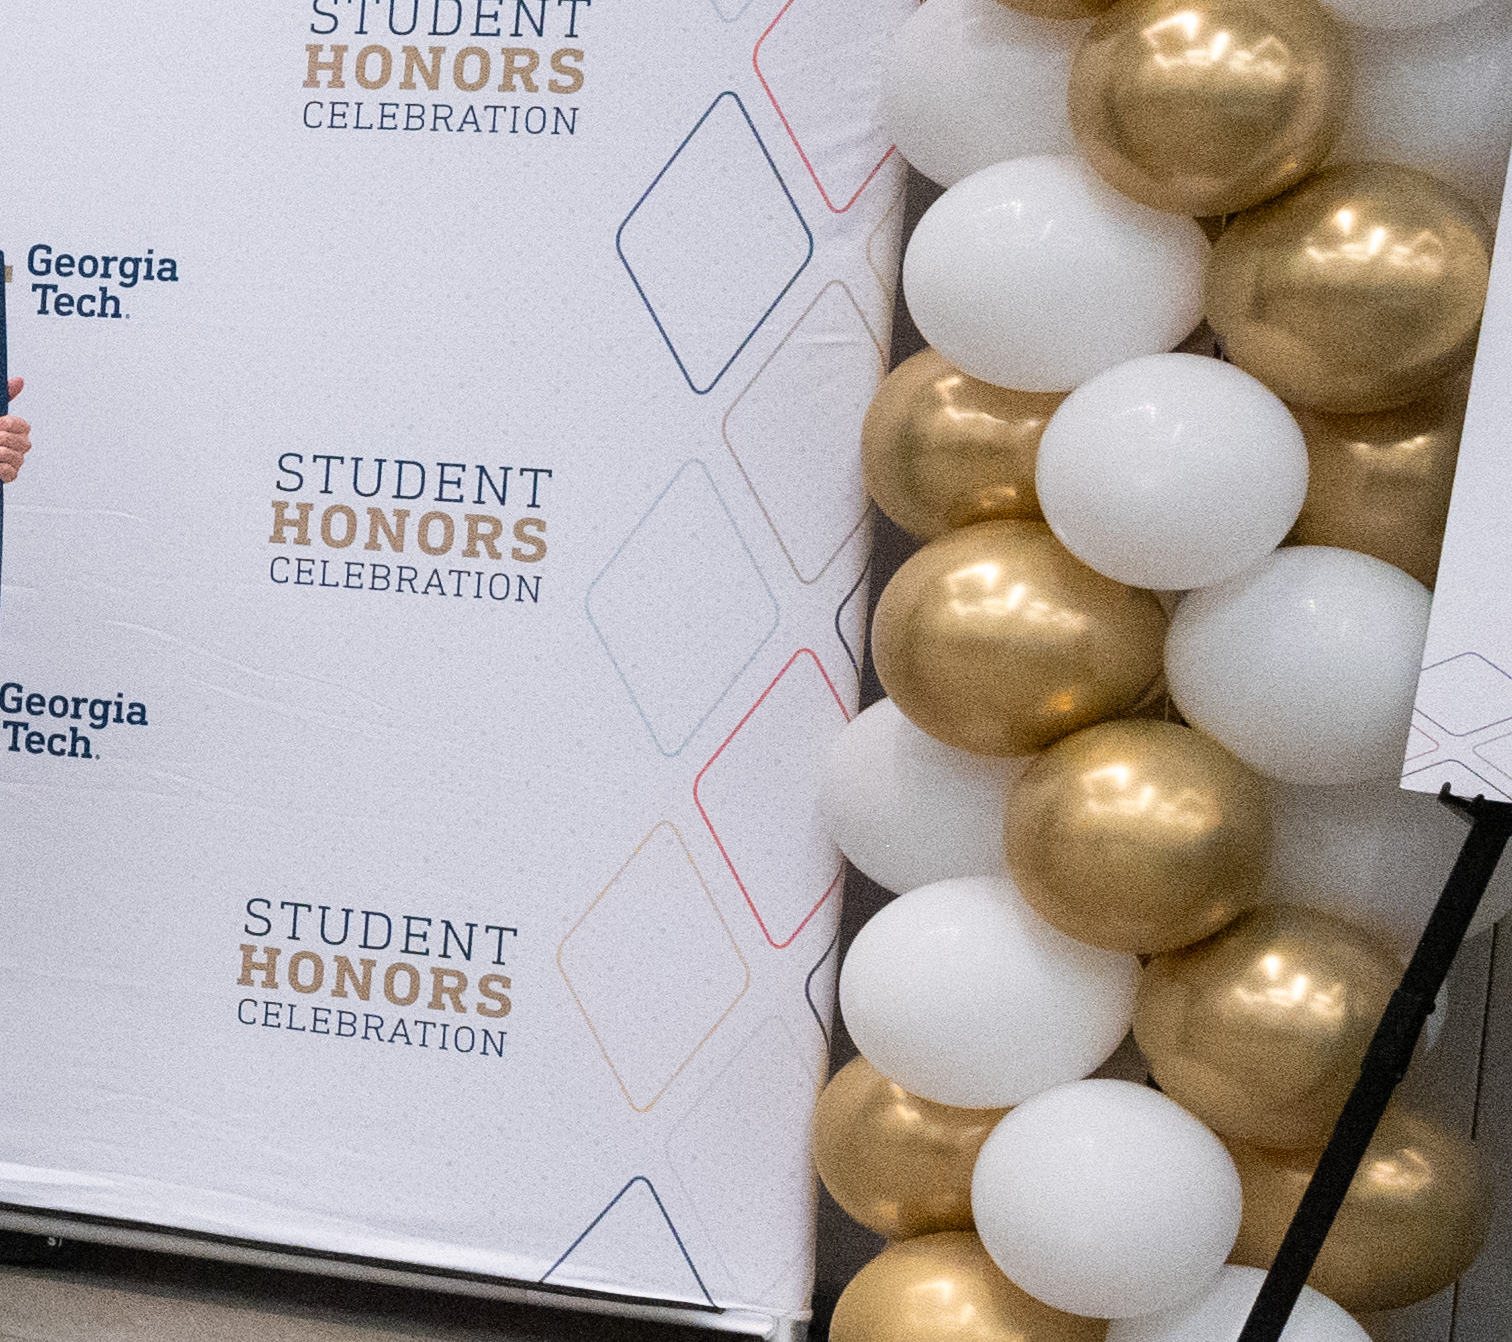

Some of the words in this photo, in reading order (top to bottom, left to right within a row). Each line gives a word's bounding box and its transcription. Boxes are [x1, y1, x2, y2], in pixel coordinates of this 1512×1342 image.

[305, 45, 583, 93] HONORS
[303, 101, 578, 135] CELEBRATION
[27, 243, 179, 289] Georgia
[276, 452, 553, 508] STUDENT
[270, 502, 546, 562] HONORS
[270, 556, 541, 603] CELEBRATION
[244, 898, 518, 966] STUDENT
[239, 945, 511, 1017] HONORS
[238, 998, 506, 1057] CELEBRATION
